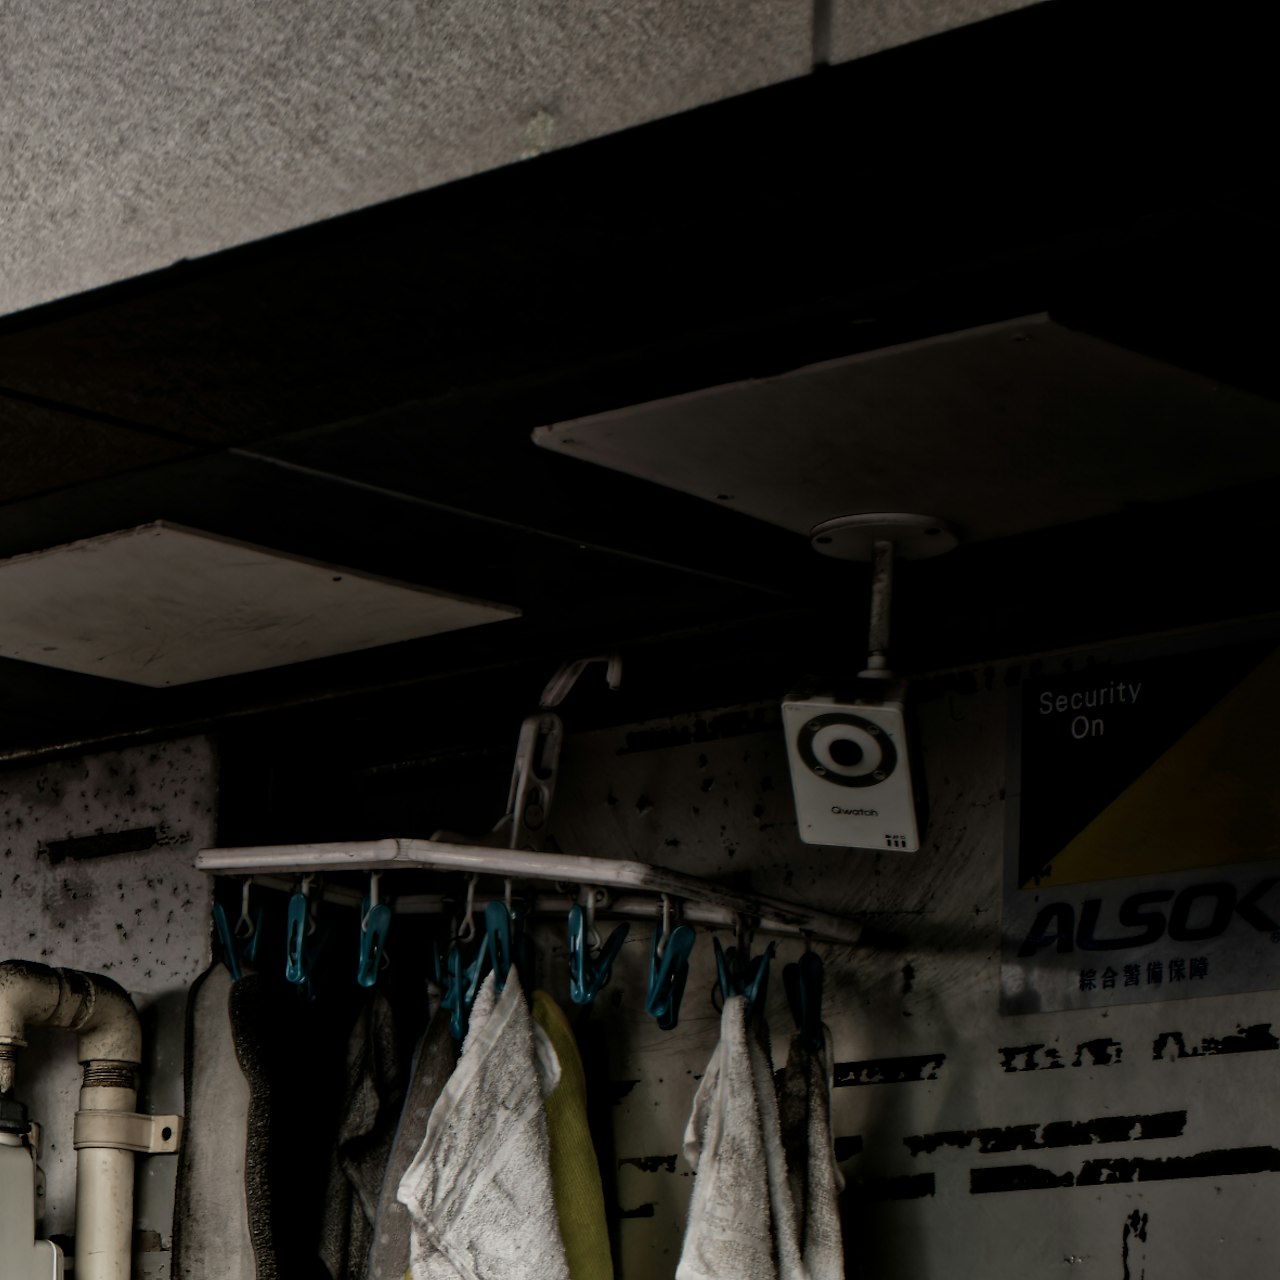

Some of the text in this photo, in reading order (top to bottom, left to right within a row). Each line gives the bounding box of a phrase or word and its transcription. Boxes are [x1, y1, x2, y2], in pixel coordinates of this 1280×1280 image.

[1039, 680, 1142, 714] Security
[1071, 715, 1105, 739] On
[1018, 878, 1280, 958] ALSOK
[1079, 956, 1209, 992] 綜合警備保障
